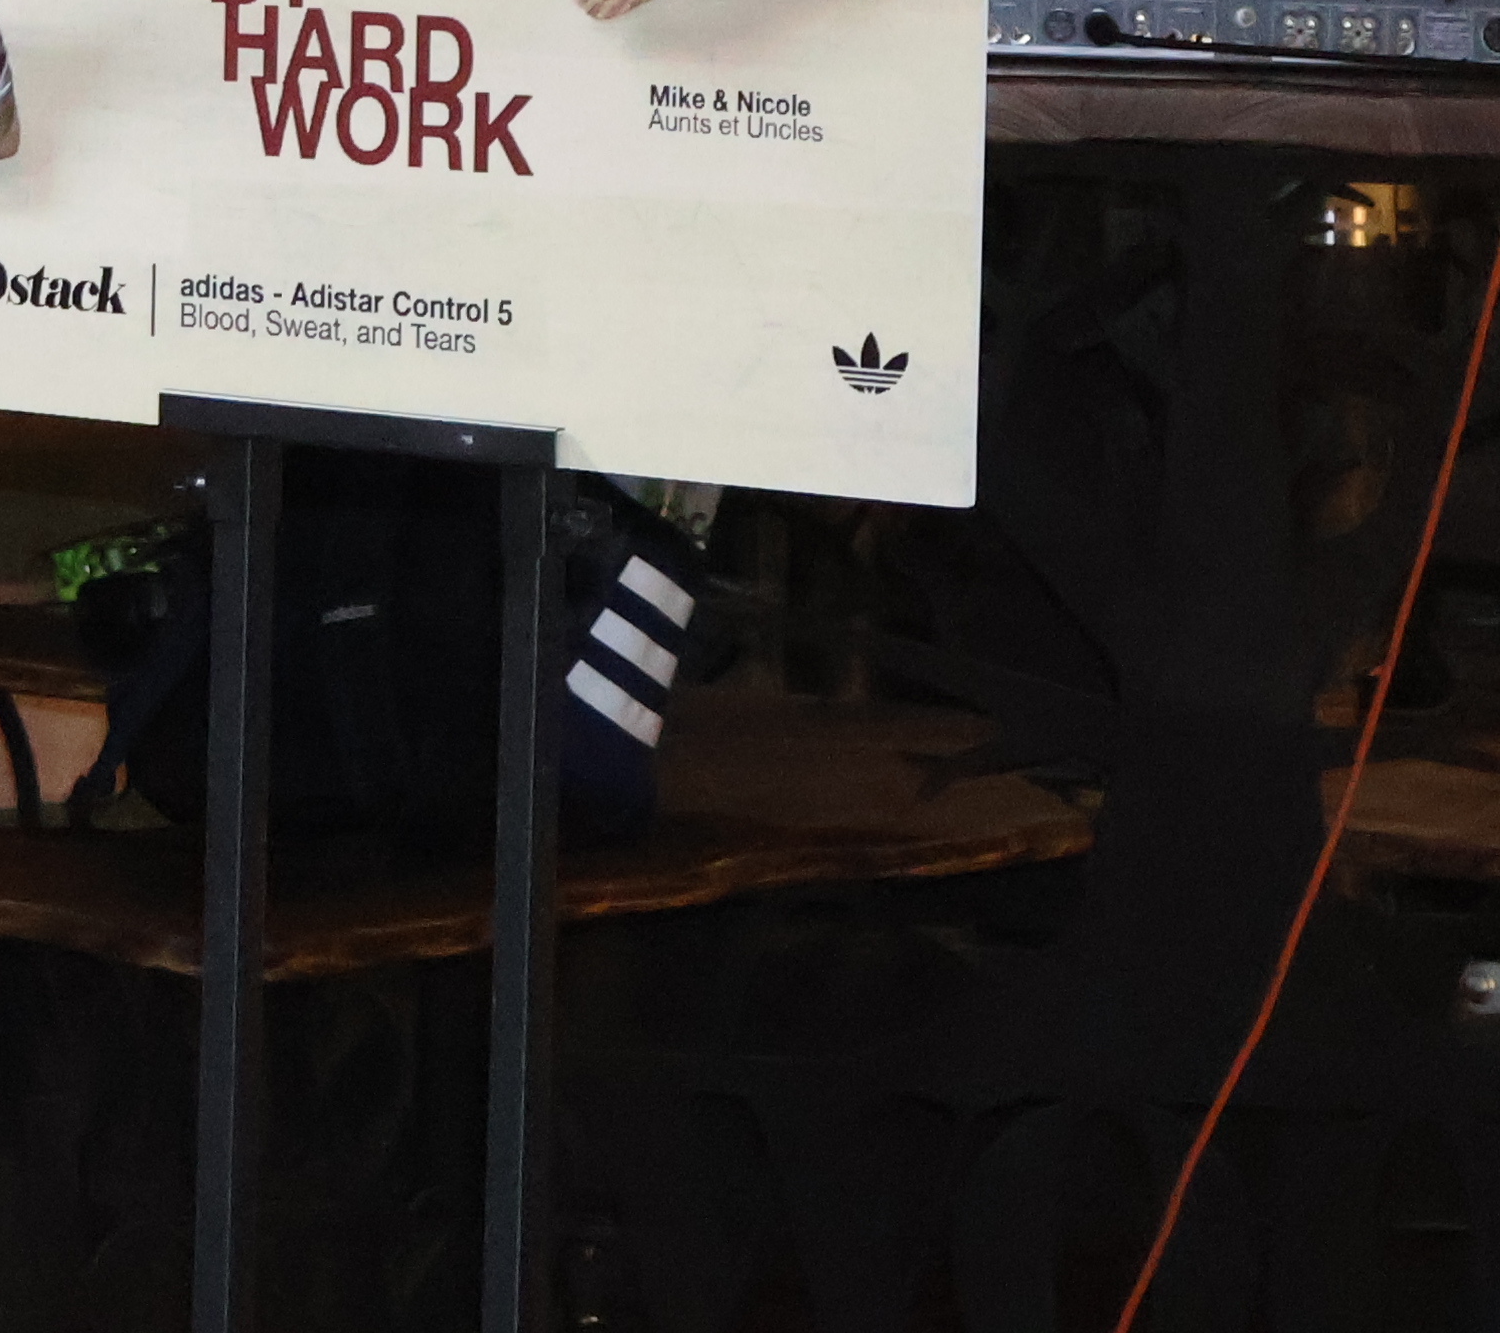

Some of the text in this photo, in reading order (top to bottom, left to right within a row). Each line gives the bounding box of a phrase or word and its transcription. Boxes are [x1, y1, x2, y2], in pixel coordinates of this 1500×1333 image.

[223, 2, 474, 94] HARD
[250, 76, 535, 177] WORK
[648, 107, 824, 143] Aunts et Uncles
[649, 84, 811, 117] Mike & Nicole
[180, 273, 265, 304] adidas
[290, 281, 385, 315] Adistar
[392, 290, 490, 325] Control
[497, 299, 514, 326] 5
[180, 302, 477, 354] Blood, Sweat, and Tears
